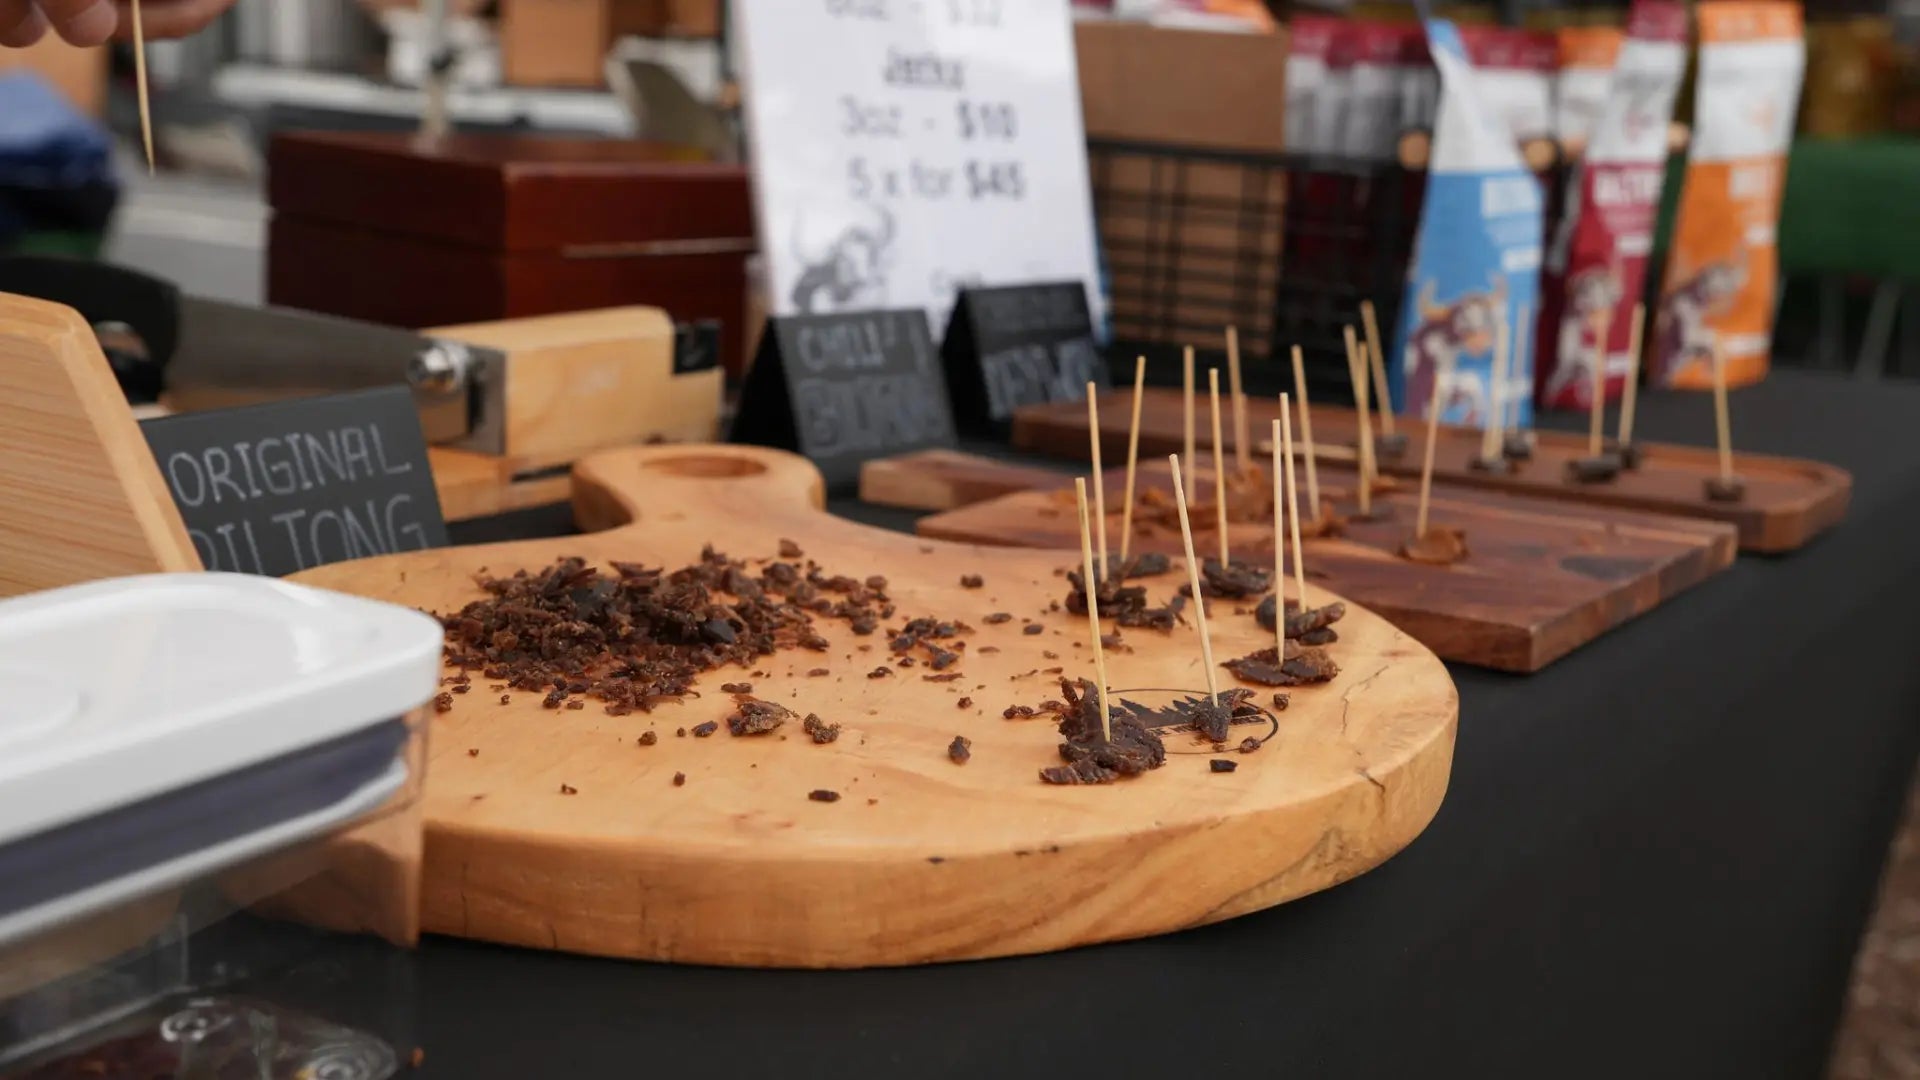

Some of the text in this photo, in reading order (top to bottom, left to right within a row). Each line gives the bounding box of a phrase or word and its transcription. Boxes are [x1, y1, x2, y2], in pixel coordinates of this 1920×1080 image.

[842, 97, 902, 136] 3oz
[957, 102, 1018, 140] $10
[966, 160, 1025, 199] $45
[168, 424, 412, 506] ORIGINAL
